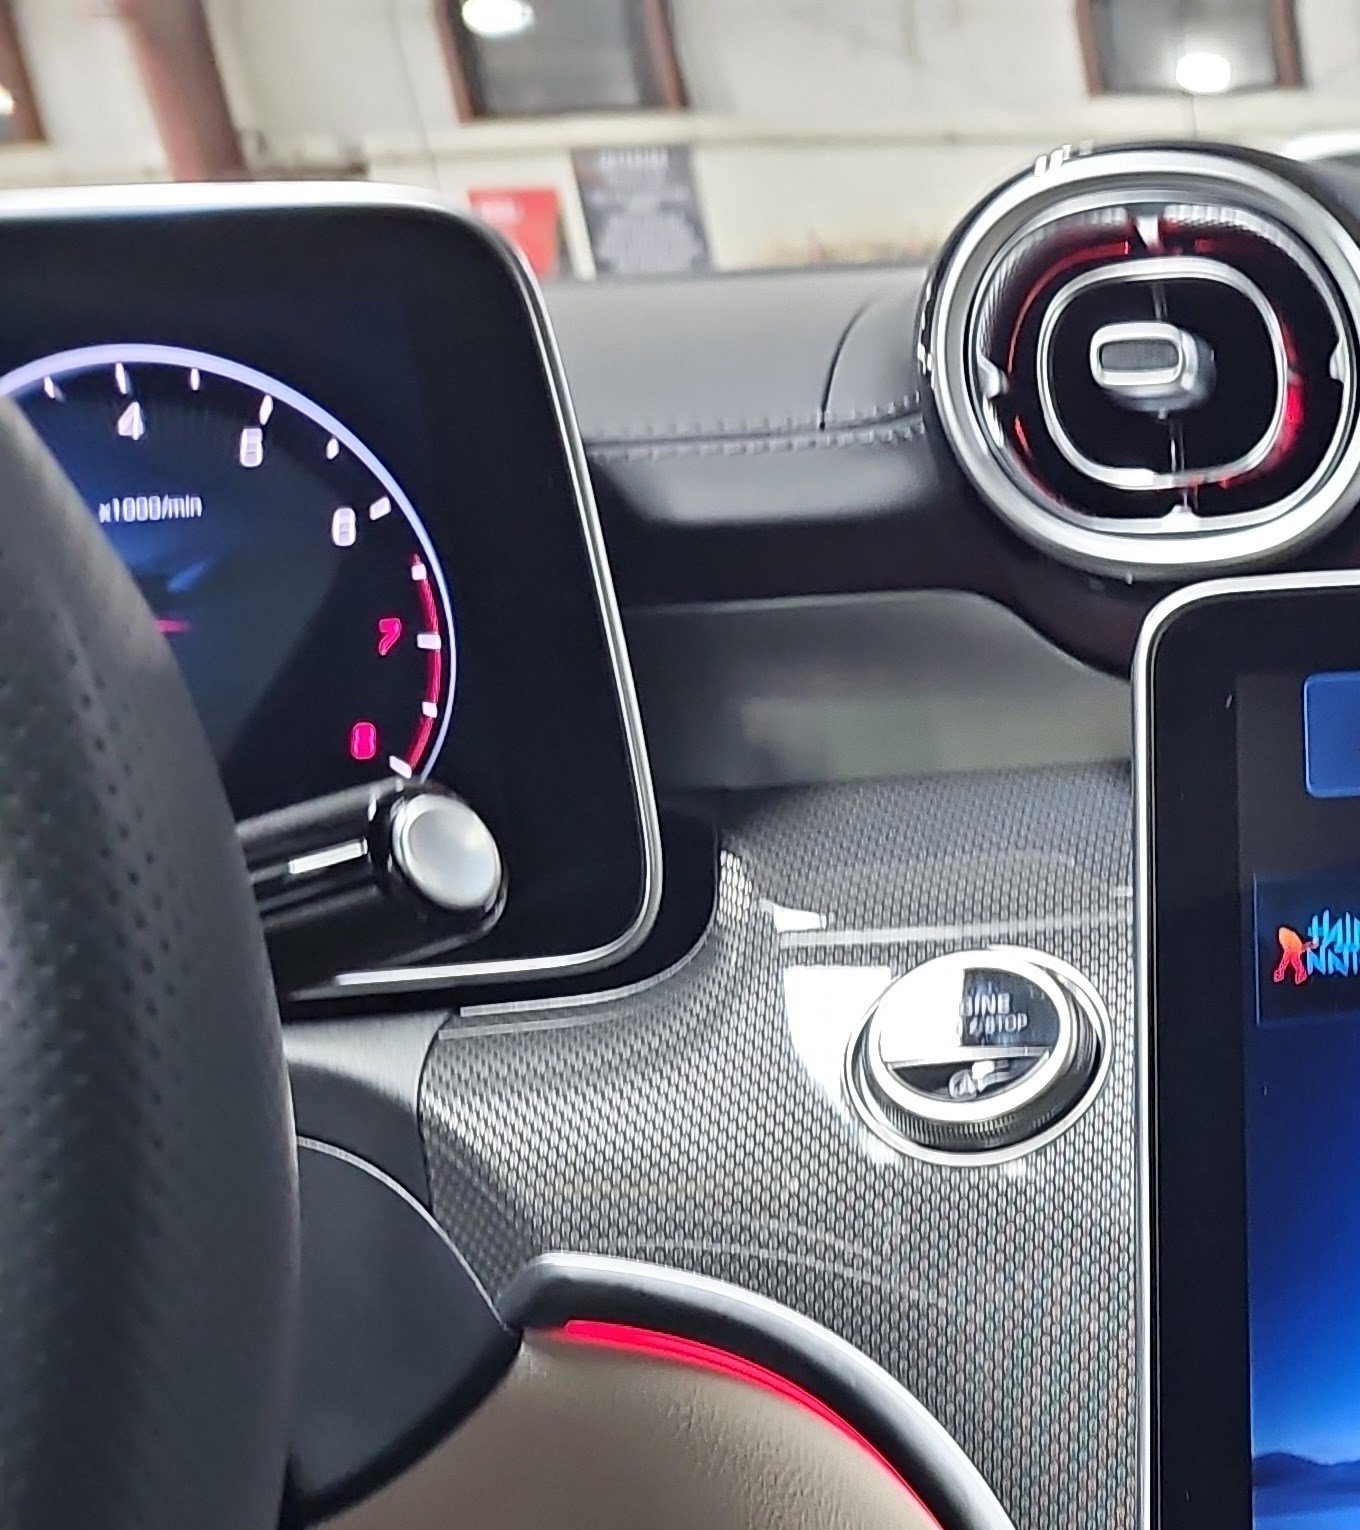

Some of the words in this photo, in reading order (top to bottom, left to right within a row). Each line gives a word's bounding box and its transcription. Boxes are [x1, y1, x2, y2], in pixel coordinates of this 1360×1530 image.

[117, 401, 145, 440] 4
[99, 494, 203, 524] x1000/min
[378, 617, 401, 656] 7
